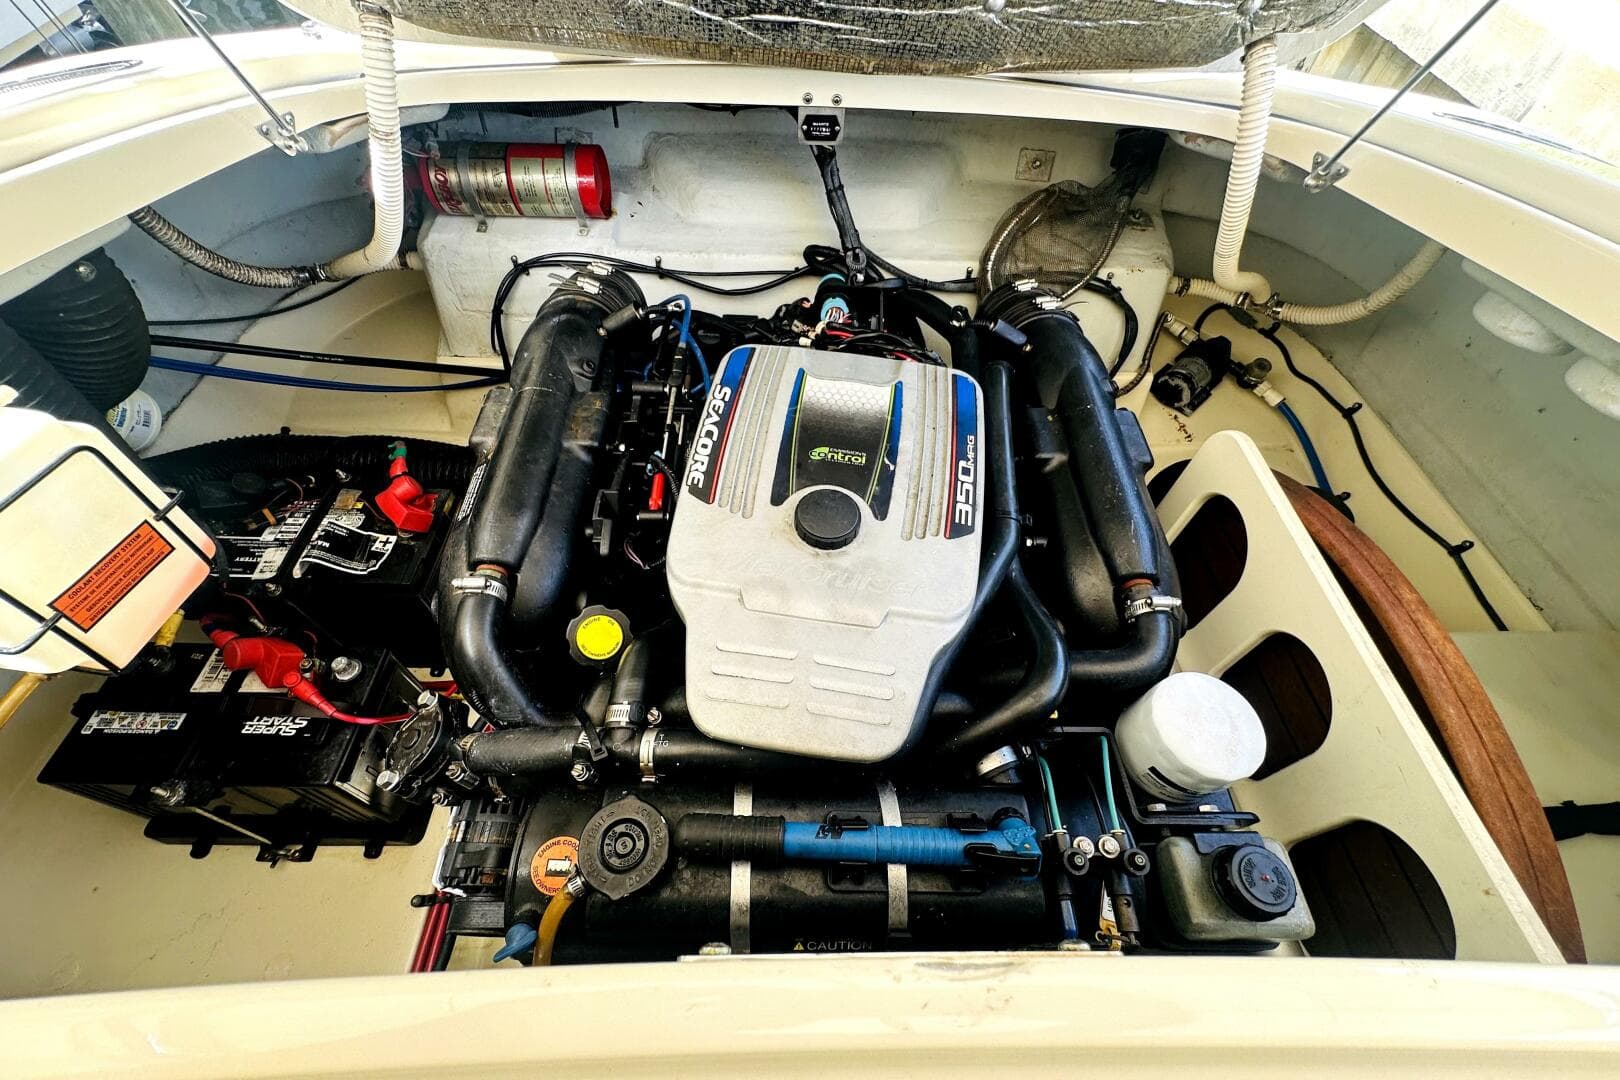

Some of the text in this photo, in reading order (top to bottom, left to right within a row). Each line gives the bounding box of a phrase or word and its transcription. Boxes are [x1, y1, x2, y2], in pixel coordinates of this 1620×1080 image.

[686, 383, 732, 490] SEACORE
[955, 434, 976, 527] 350 MAG
[68, 534, 141, 599] COOLANT RECOVERY SYSTEM
[245, 715, 311, 727] START
[241, 724, 299, 736] SUPER
[537, 839, 580, 858] ENGINE COOL
[533, 865, 541, 880] SEE
[807, 940, 872, 951] CAUTION
